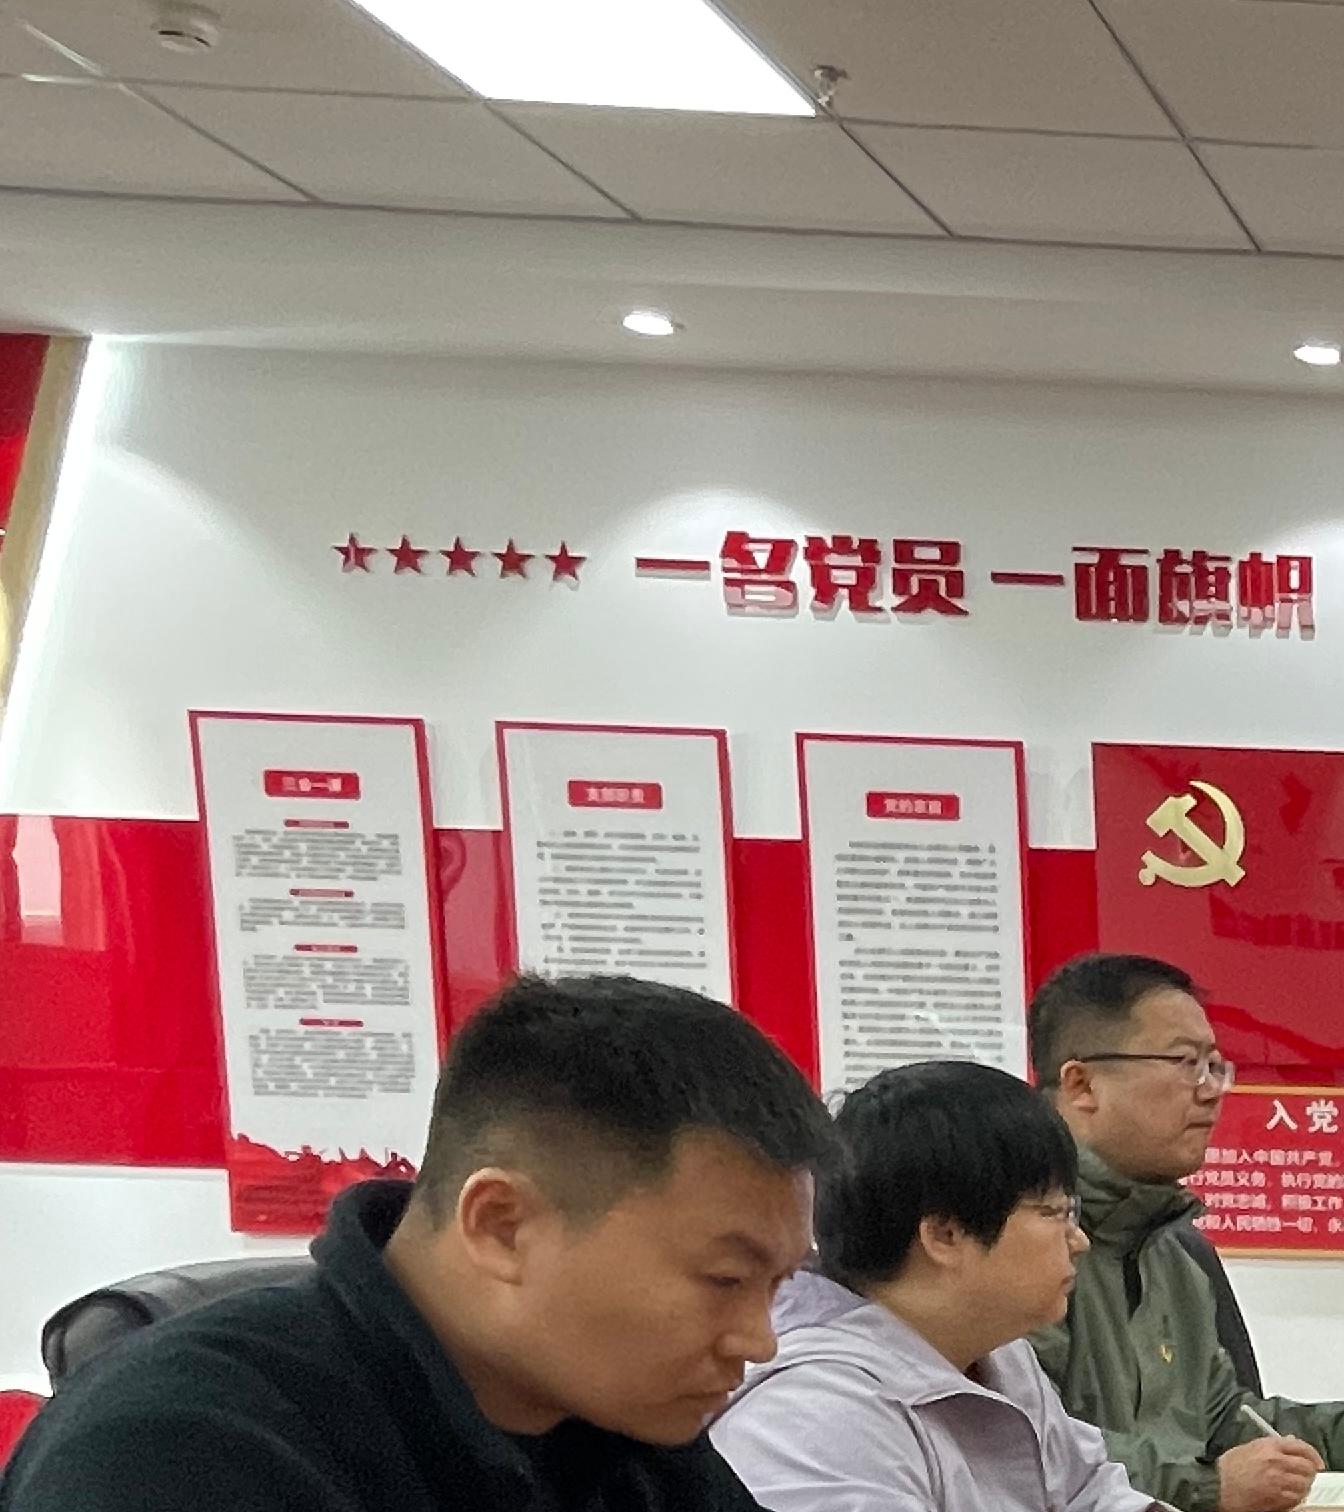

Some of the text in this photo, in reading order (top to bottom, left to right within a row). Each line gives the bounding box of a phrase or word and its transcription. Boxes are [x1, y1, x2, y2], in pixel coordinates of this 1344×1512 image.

[634, 530, 969, 618] 一名党员
[991, 546, 1314, 631] 一面旗帜
